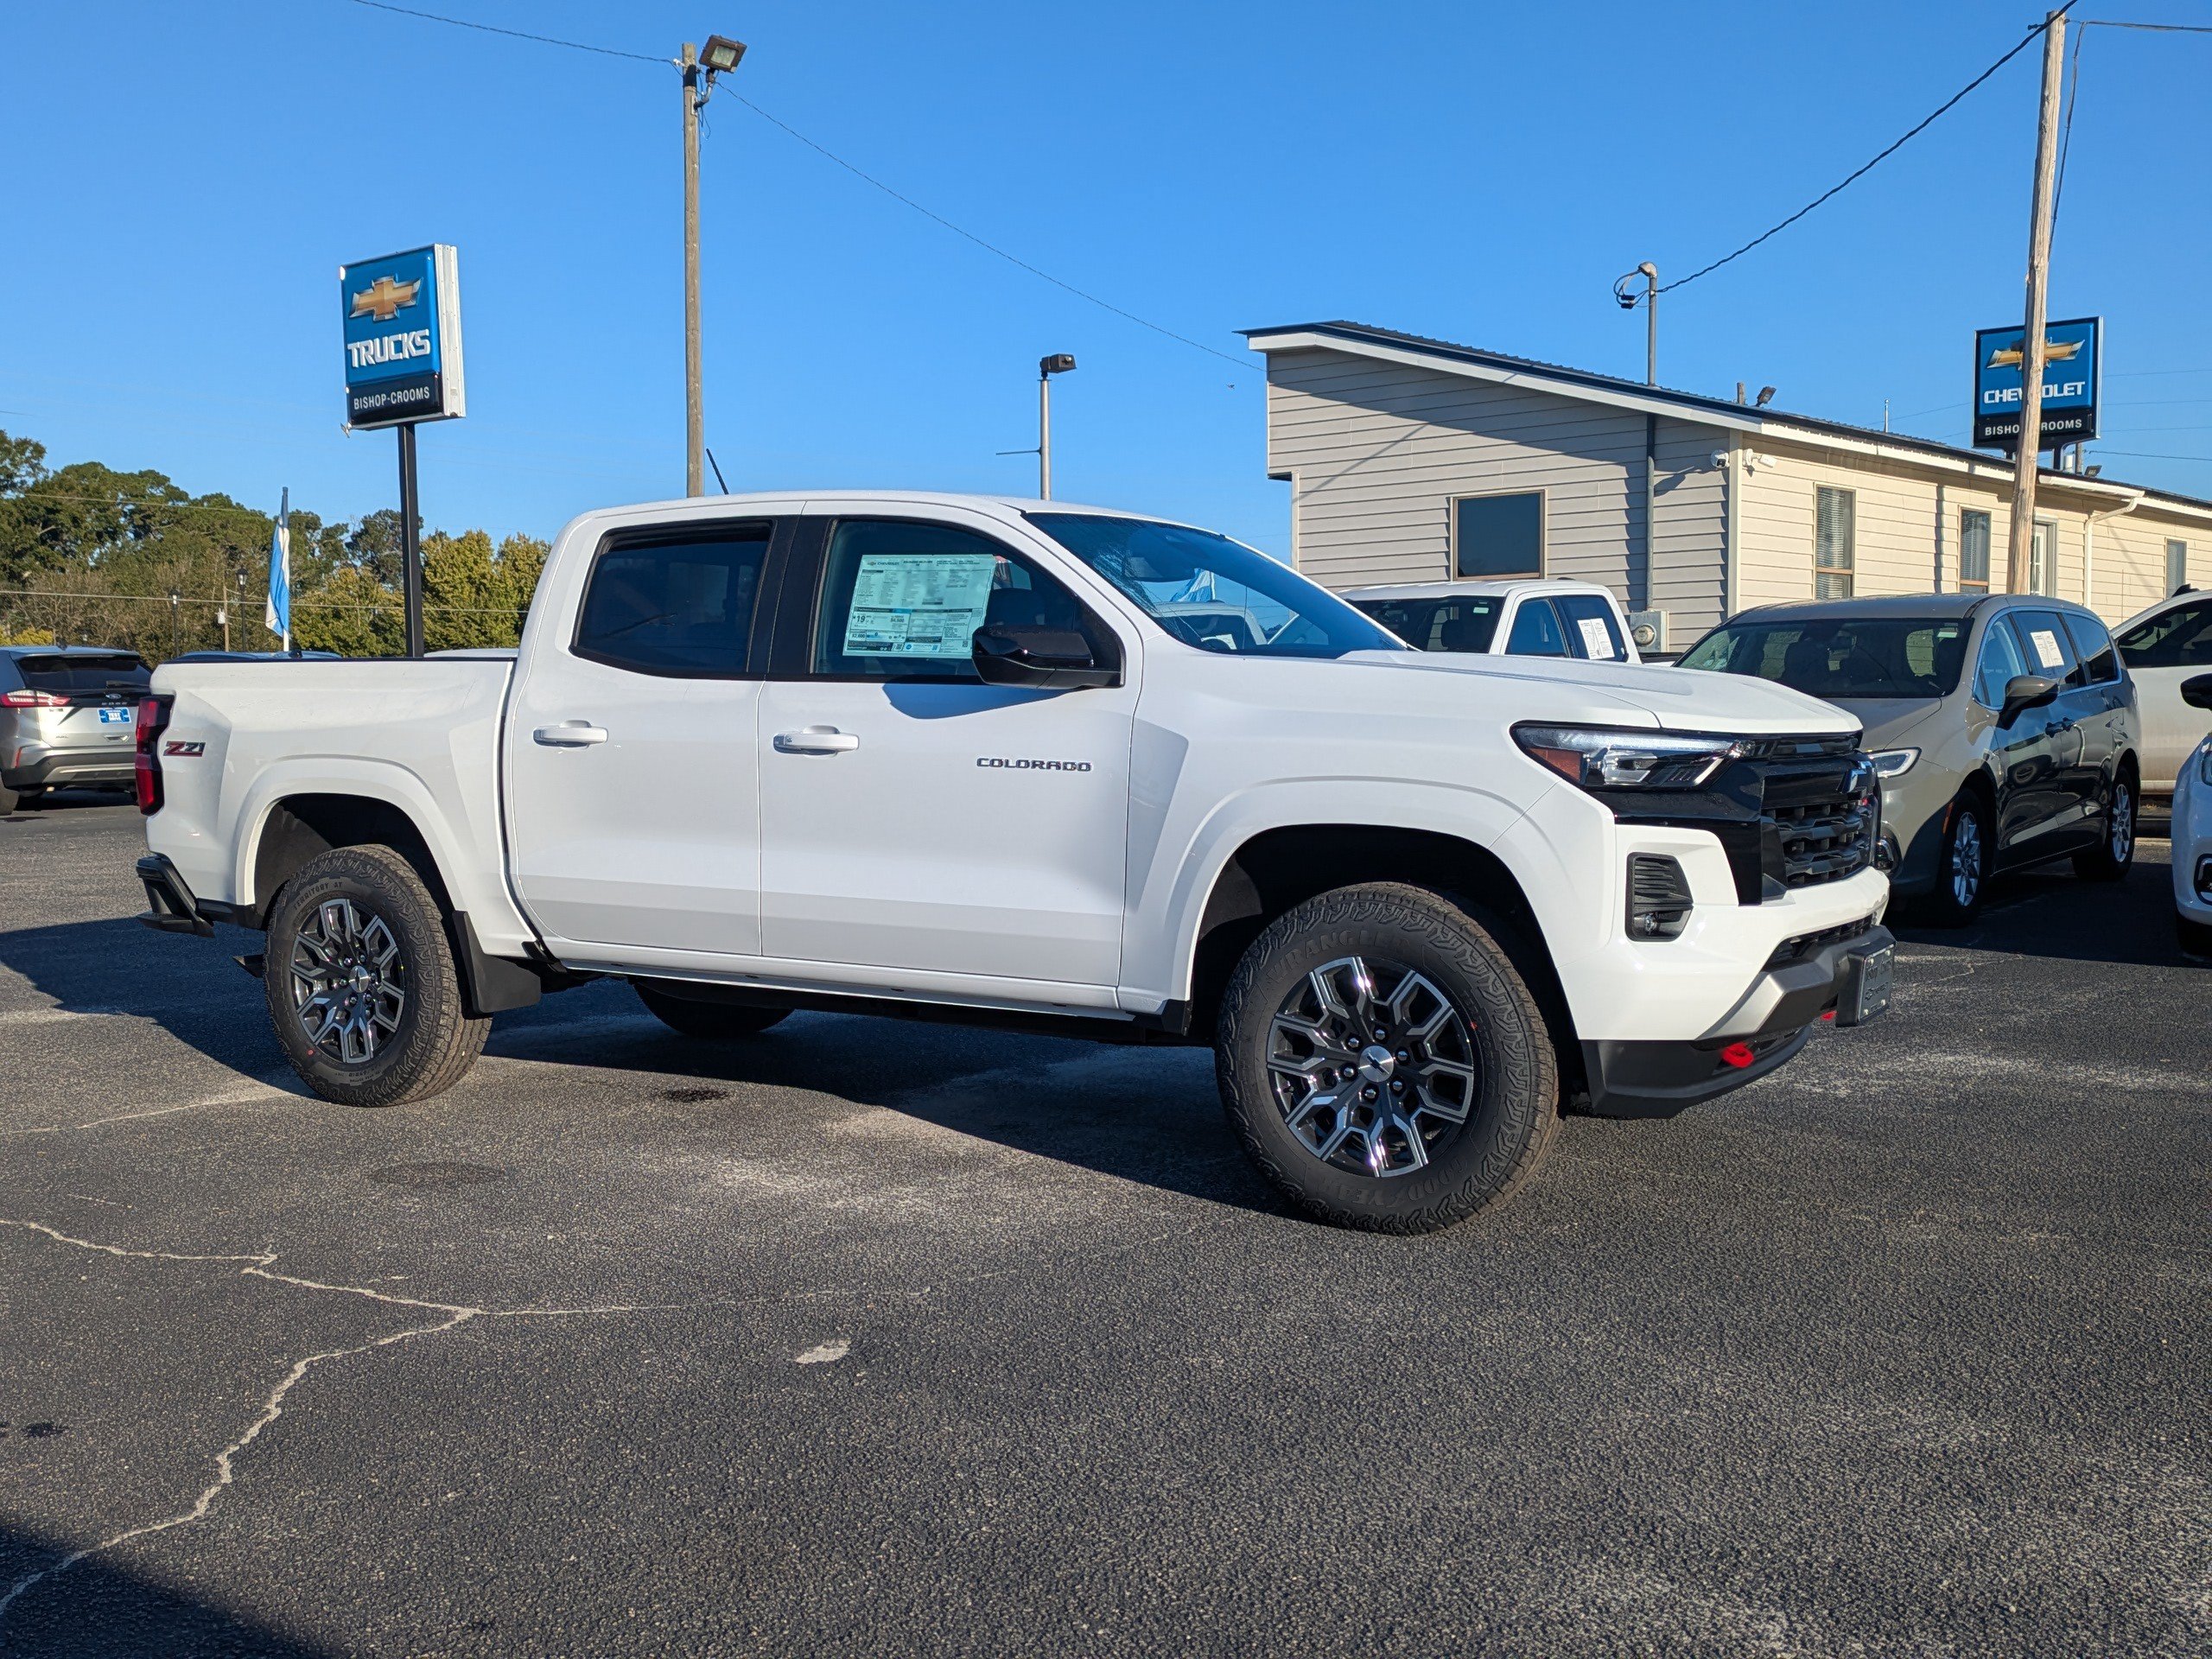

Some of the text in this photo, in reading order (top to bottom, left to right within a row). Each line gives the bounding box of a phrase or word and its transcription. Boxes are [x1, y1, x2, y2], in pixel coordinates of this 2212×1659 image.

[346, 328, 431, 368] TRUCKS
[353, 386, 430, 410] BISHOP-CROOMS
[1983, 380, 2086, 404] CHEOLET
[1985, 418, 2082, 436] BISHOROOMS
[162, 741, 206, 757] Z71
[976, 758, 1091, 772] COLORADO
